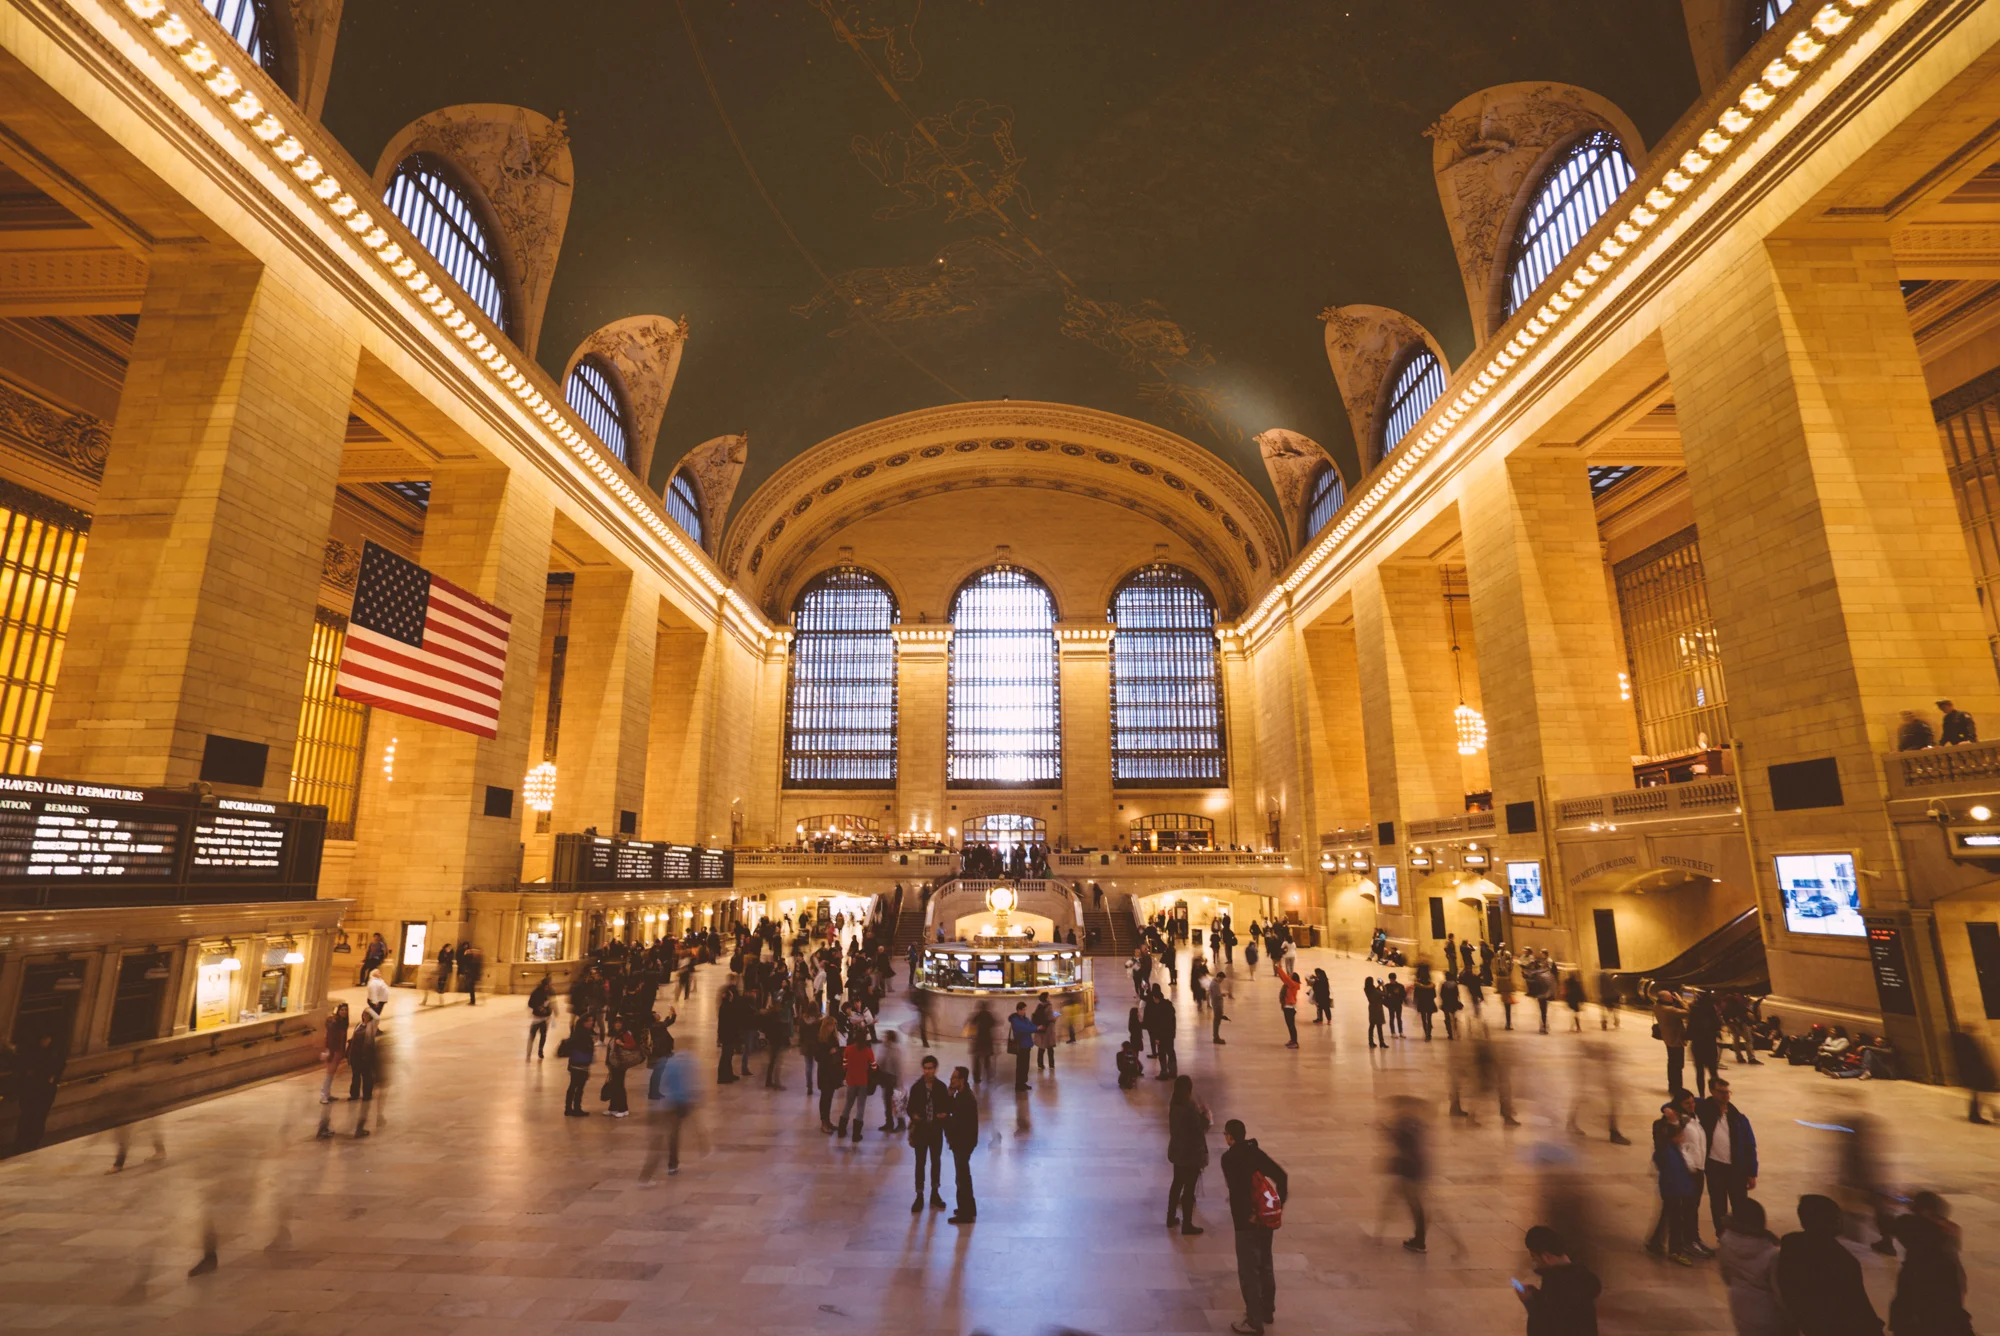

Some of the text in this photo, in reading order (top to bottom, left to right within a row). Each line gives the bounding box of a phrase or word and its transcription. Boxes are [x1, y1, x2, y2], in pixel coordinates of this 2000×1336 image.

[0, 778, 144, 801] HAVEN LINE DEPARTURES
[44, 803, 90, 815] REMARKS
[219, 799, 276, 814] INFORMATION
[1660, 855, 1715, 873] 45TH STREET
